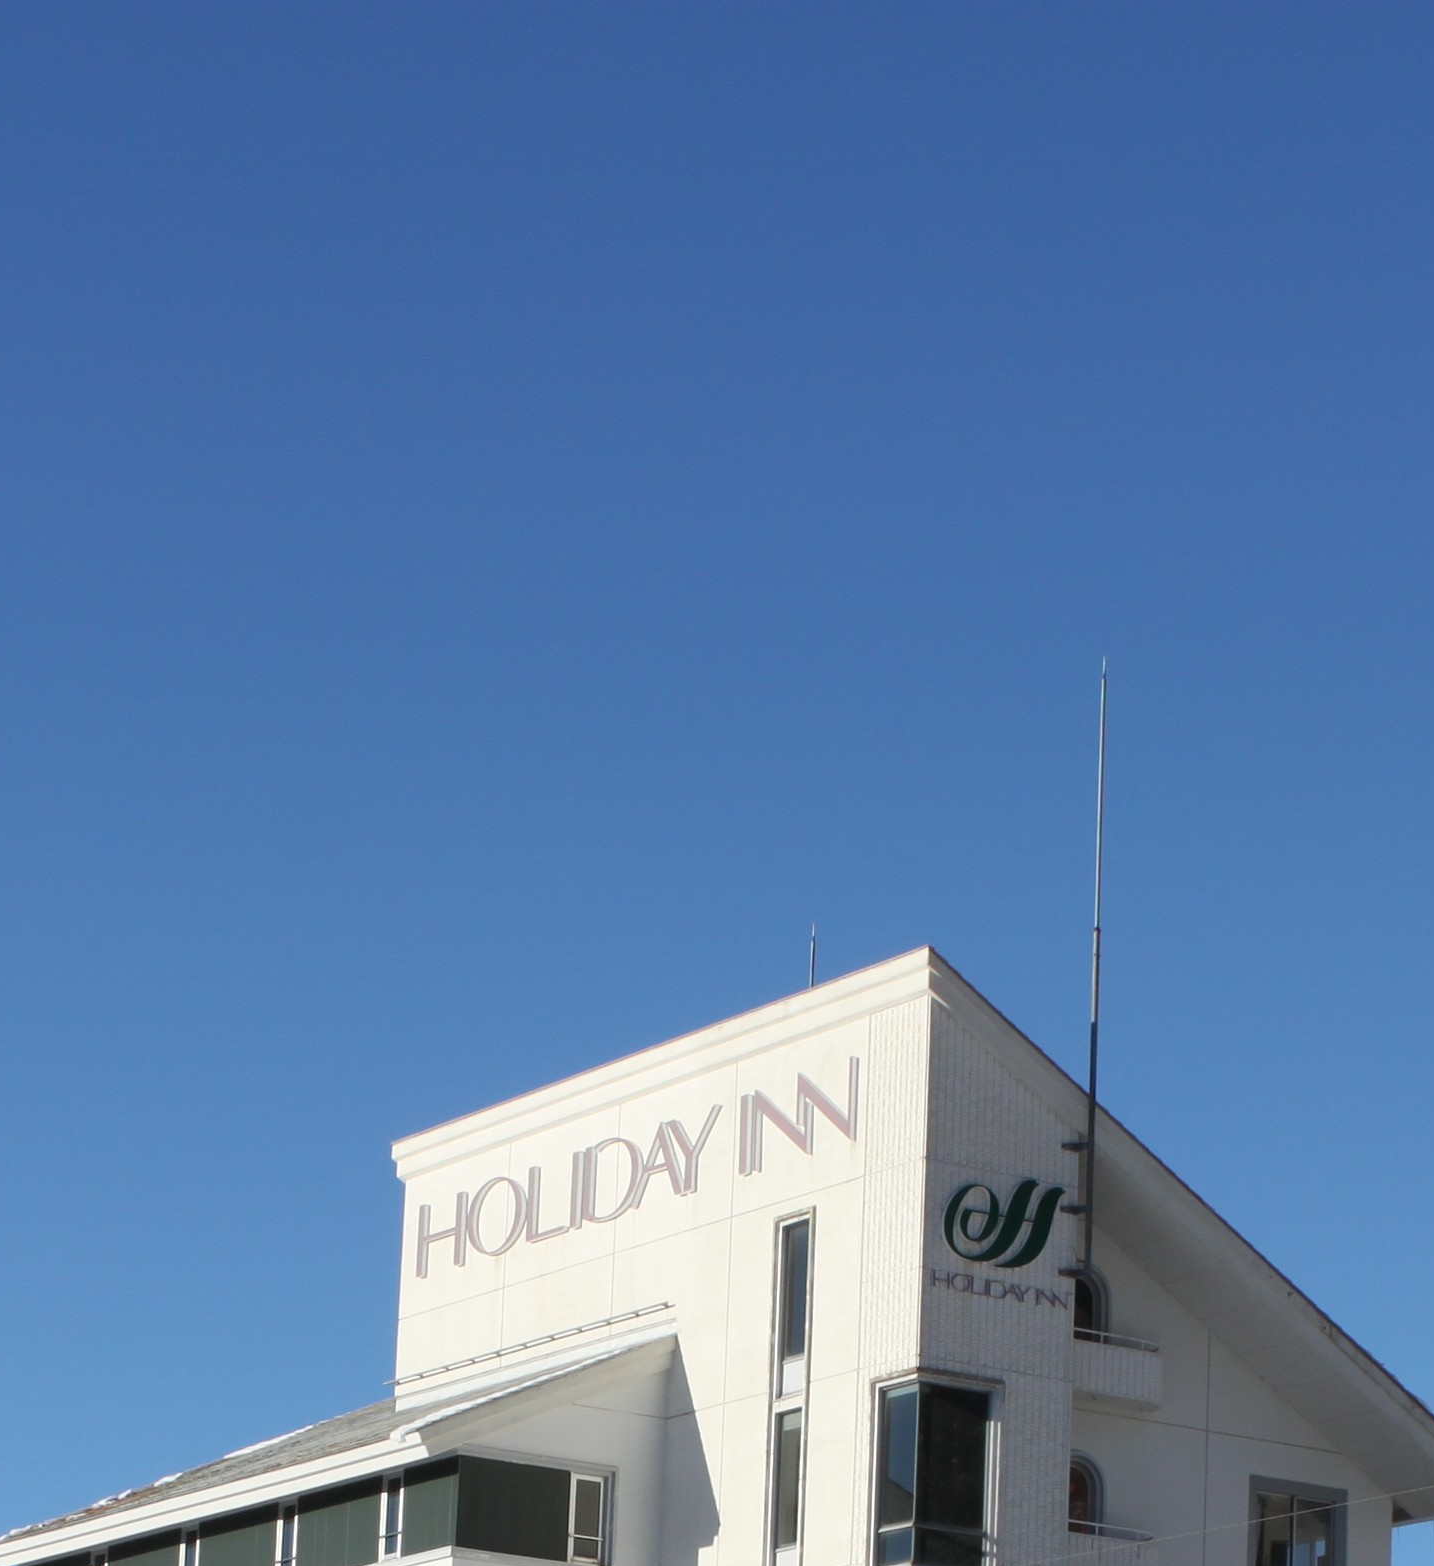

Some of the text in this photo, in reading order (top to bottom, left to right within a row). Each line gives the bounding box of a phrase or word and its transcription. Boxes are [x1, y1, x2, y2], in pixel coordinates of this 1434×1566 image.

[416, 1056, 860, 1279] HOLIDAY INN
[932, 1269, 1068, 1311] HOLIDAY INN
